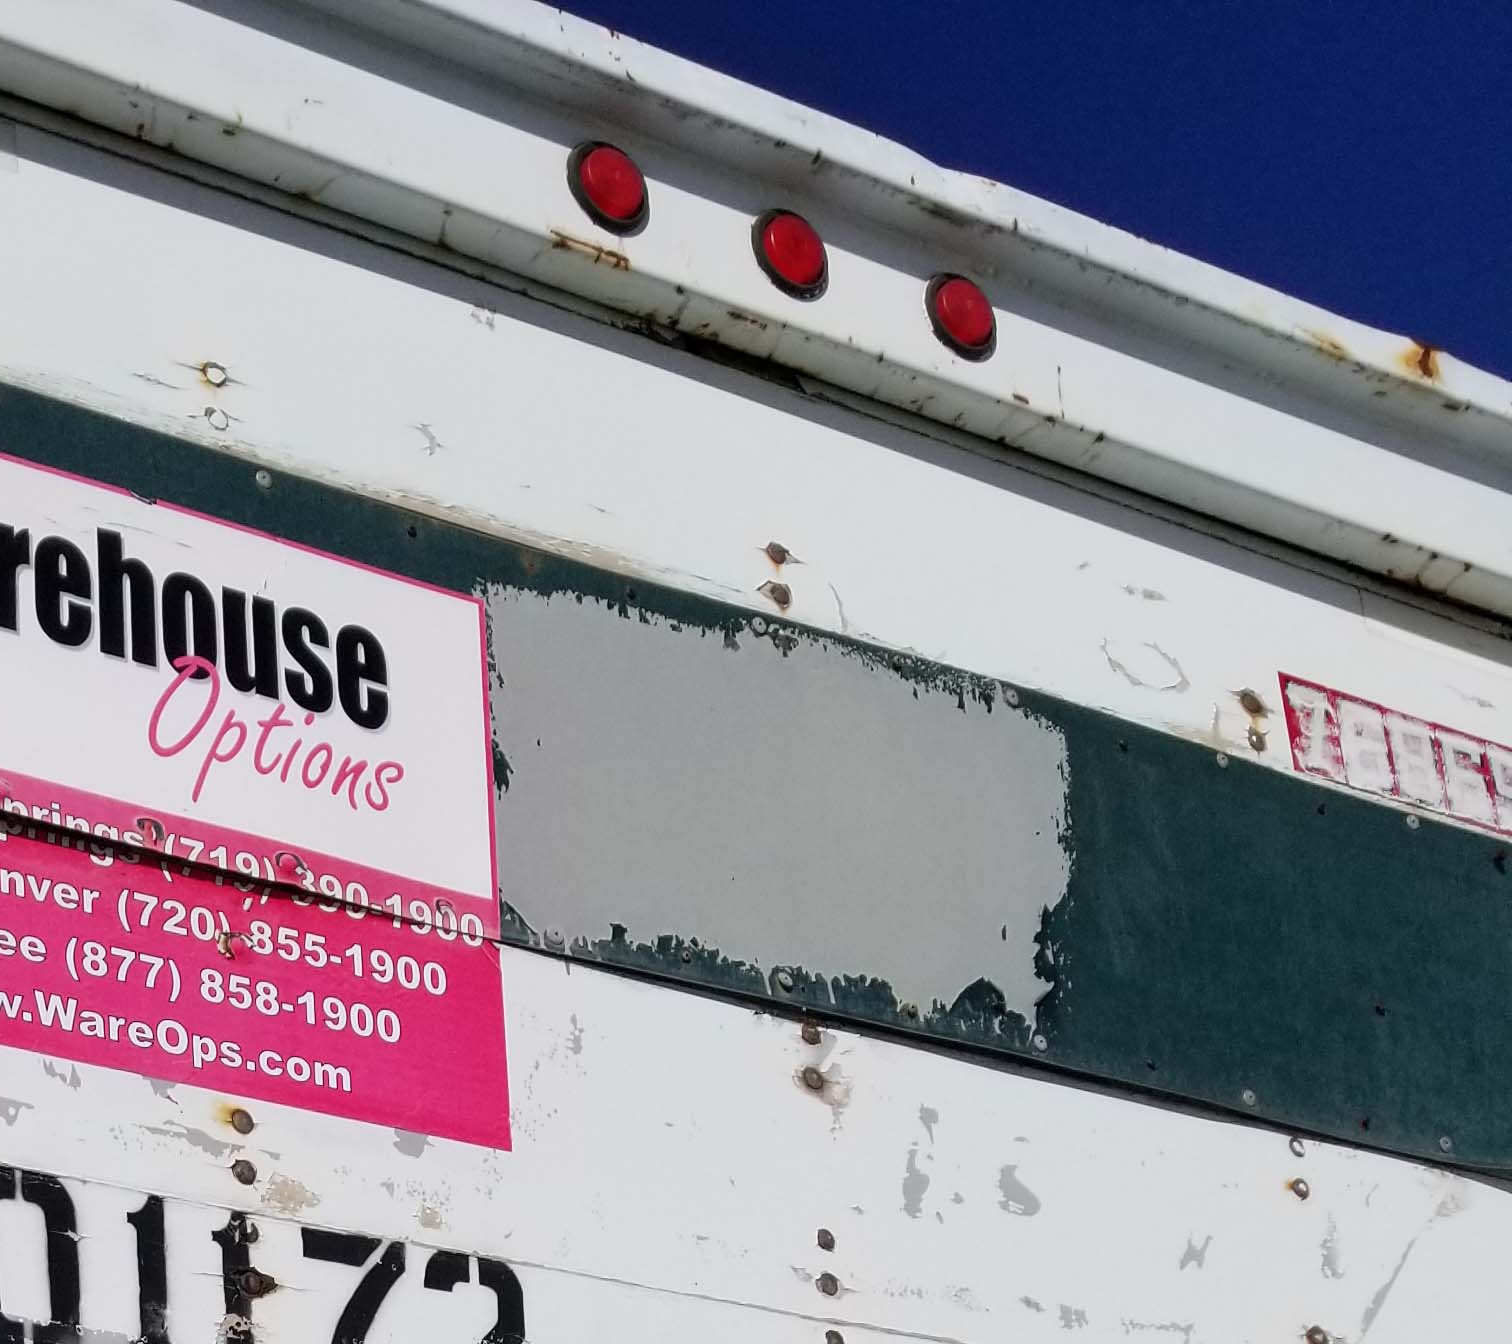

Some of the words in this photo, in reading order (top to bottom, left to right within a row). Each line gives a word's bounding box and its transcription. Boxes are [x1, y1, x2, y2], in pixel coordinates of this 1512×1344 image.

[147, 655, 405, 812] Options
[64, 936, 183, 1004] (877)
[199, 967, 402, 1044] 858-1900
[117, 888, 231, 944] (720)
[248, 919, 449, 997] 855-1900
